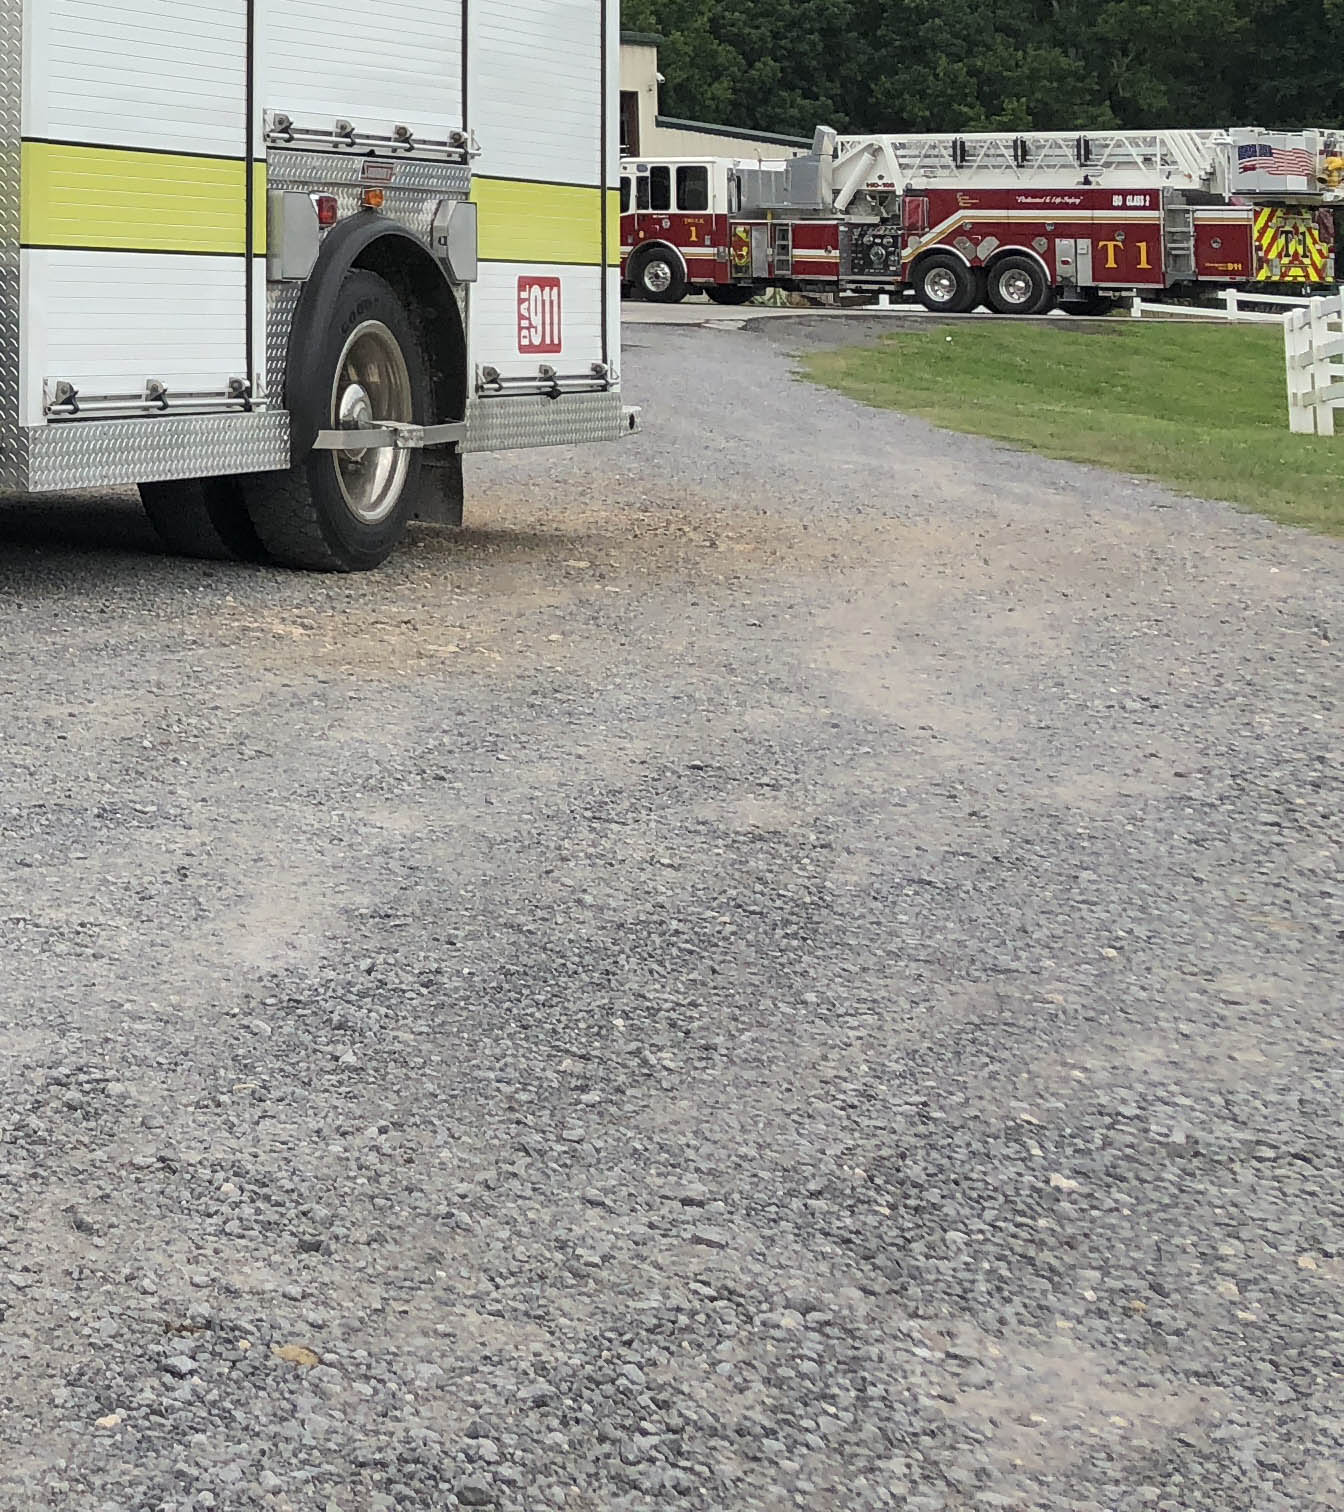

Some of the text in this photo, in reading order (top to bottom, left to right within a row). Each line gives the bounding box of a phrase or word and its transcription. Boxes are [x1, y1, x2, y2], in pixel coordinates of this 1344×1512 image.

[689, 226, 698, 241] 1
[520, 285, 530, 345] DIAL
[530, 284, 560, 346] 911
